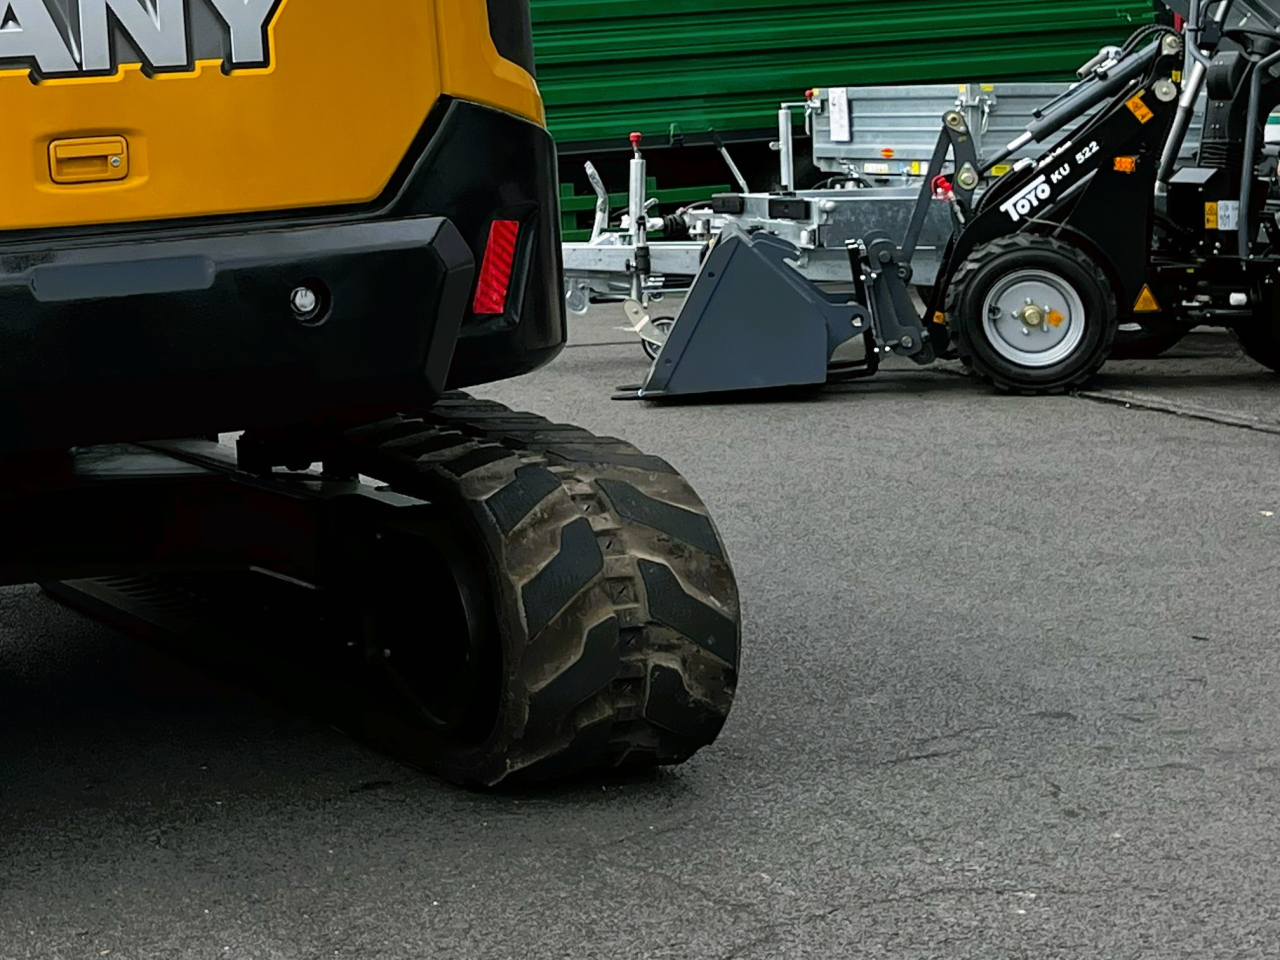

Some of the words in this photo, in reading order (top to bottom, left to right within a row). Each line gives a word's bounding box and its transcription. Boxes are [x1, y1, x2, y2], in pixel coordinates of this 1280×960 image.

[999, 174, 1051, 221] TOYO
[1050, 163, 1070, 184] KU
[1075, 141, 1099, 164] 522
